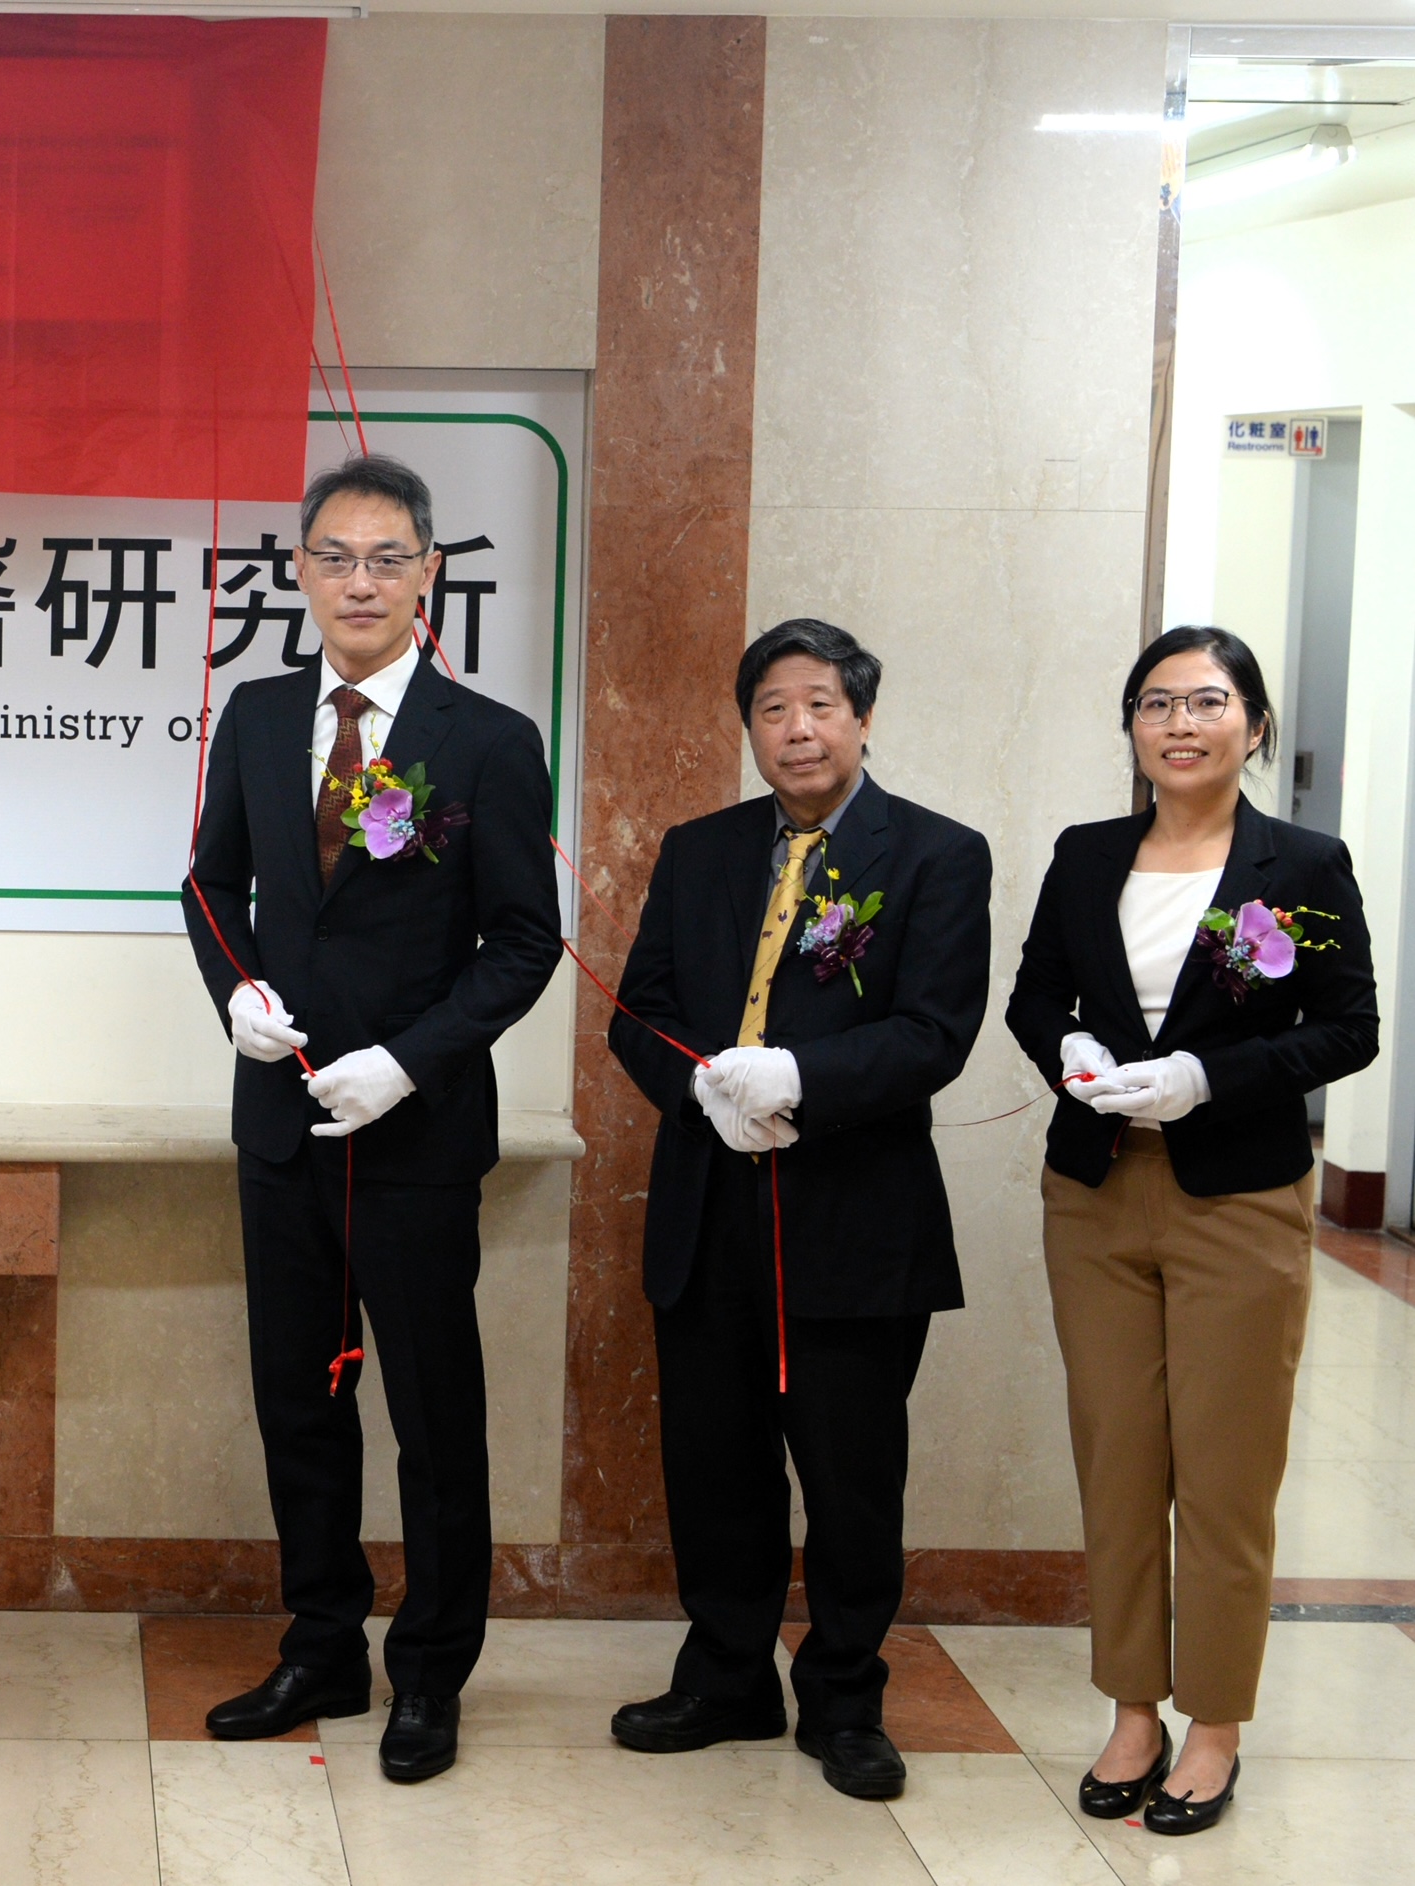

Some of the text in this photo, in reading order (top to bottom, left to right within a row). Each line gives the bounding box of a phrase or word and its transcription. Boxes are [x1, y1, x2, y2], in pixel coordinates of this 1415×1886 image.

[1229, 421, 1286, 438] 化粧室
[1228, 441, 1284, 451] Restrooms
